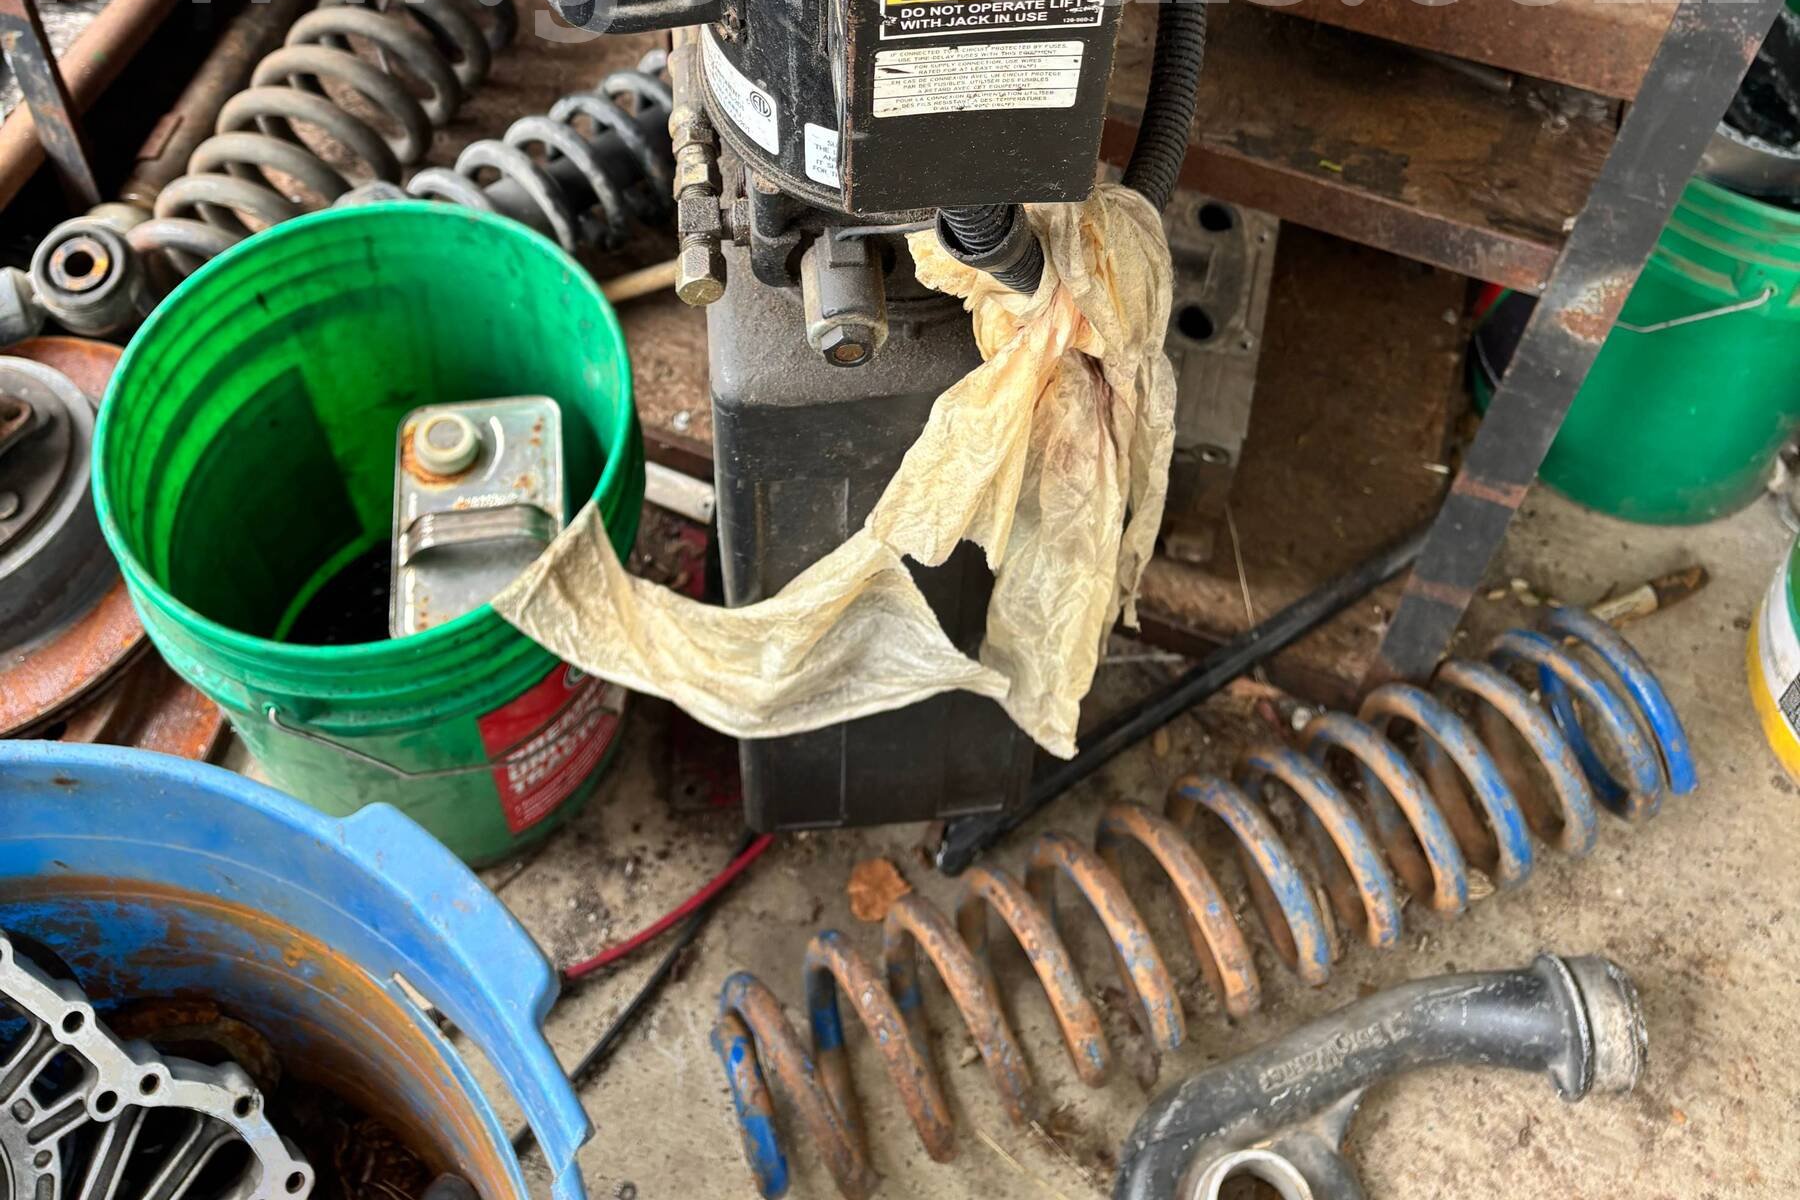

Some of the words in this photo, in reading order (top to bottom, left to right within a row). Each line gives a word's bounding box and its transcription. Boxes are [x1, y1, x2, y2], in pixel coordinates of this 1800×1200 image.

[901, 7, 926, 19] DO
[930, 4, 964, 17] NOT
[968, 0, 1045, 13] OPERATE
[900, 17, 941, 30] WITH
[944, 15, 989, 28] JACK
[995, 13, 1012, 24] IN
[1015, 11, 1048, 23] USE
